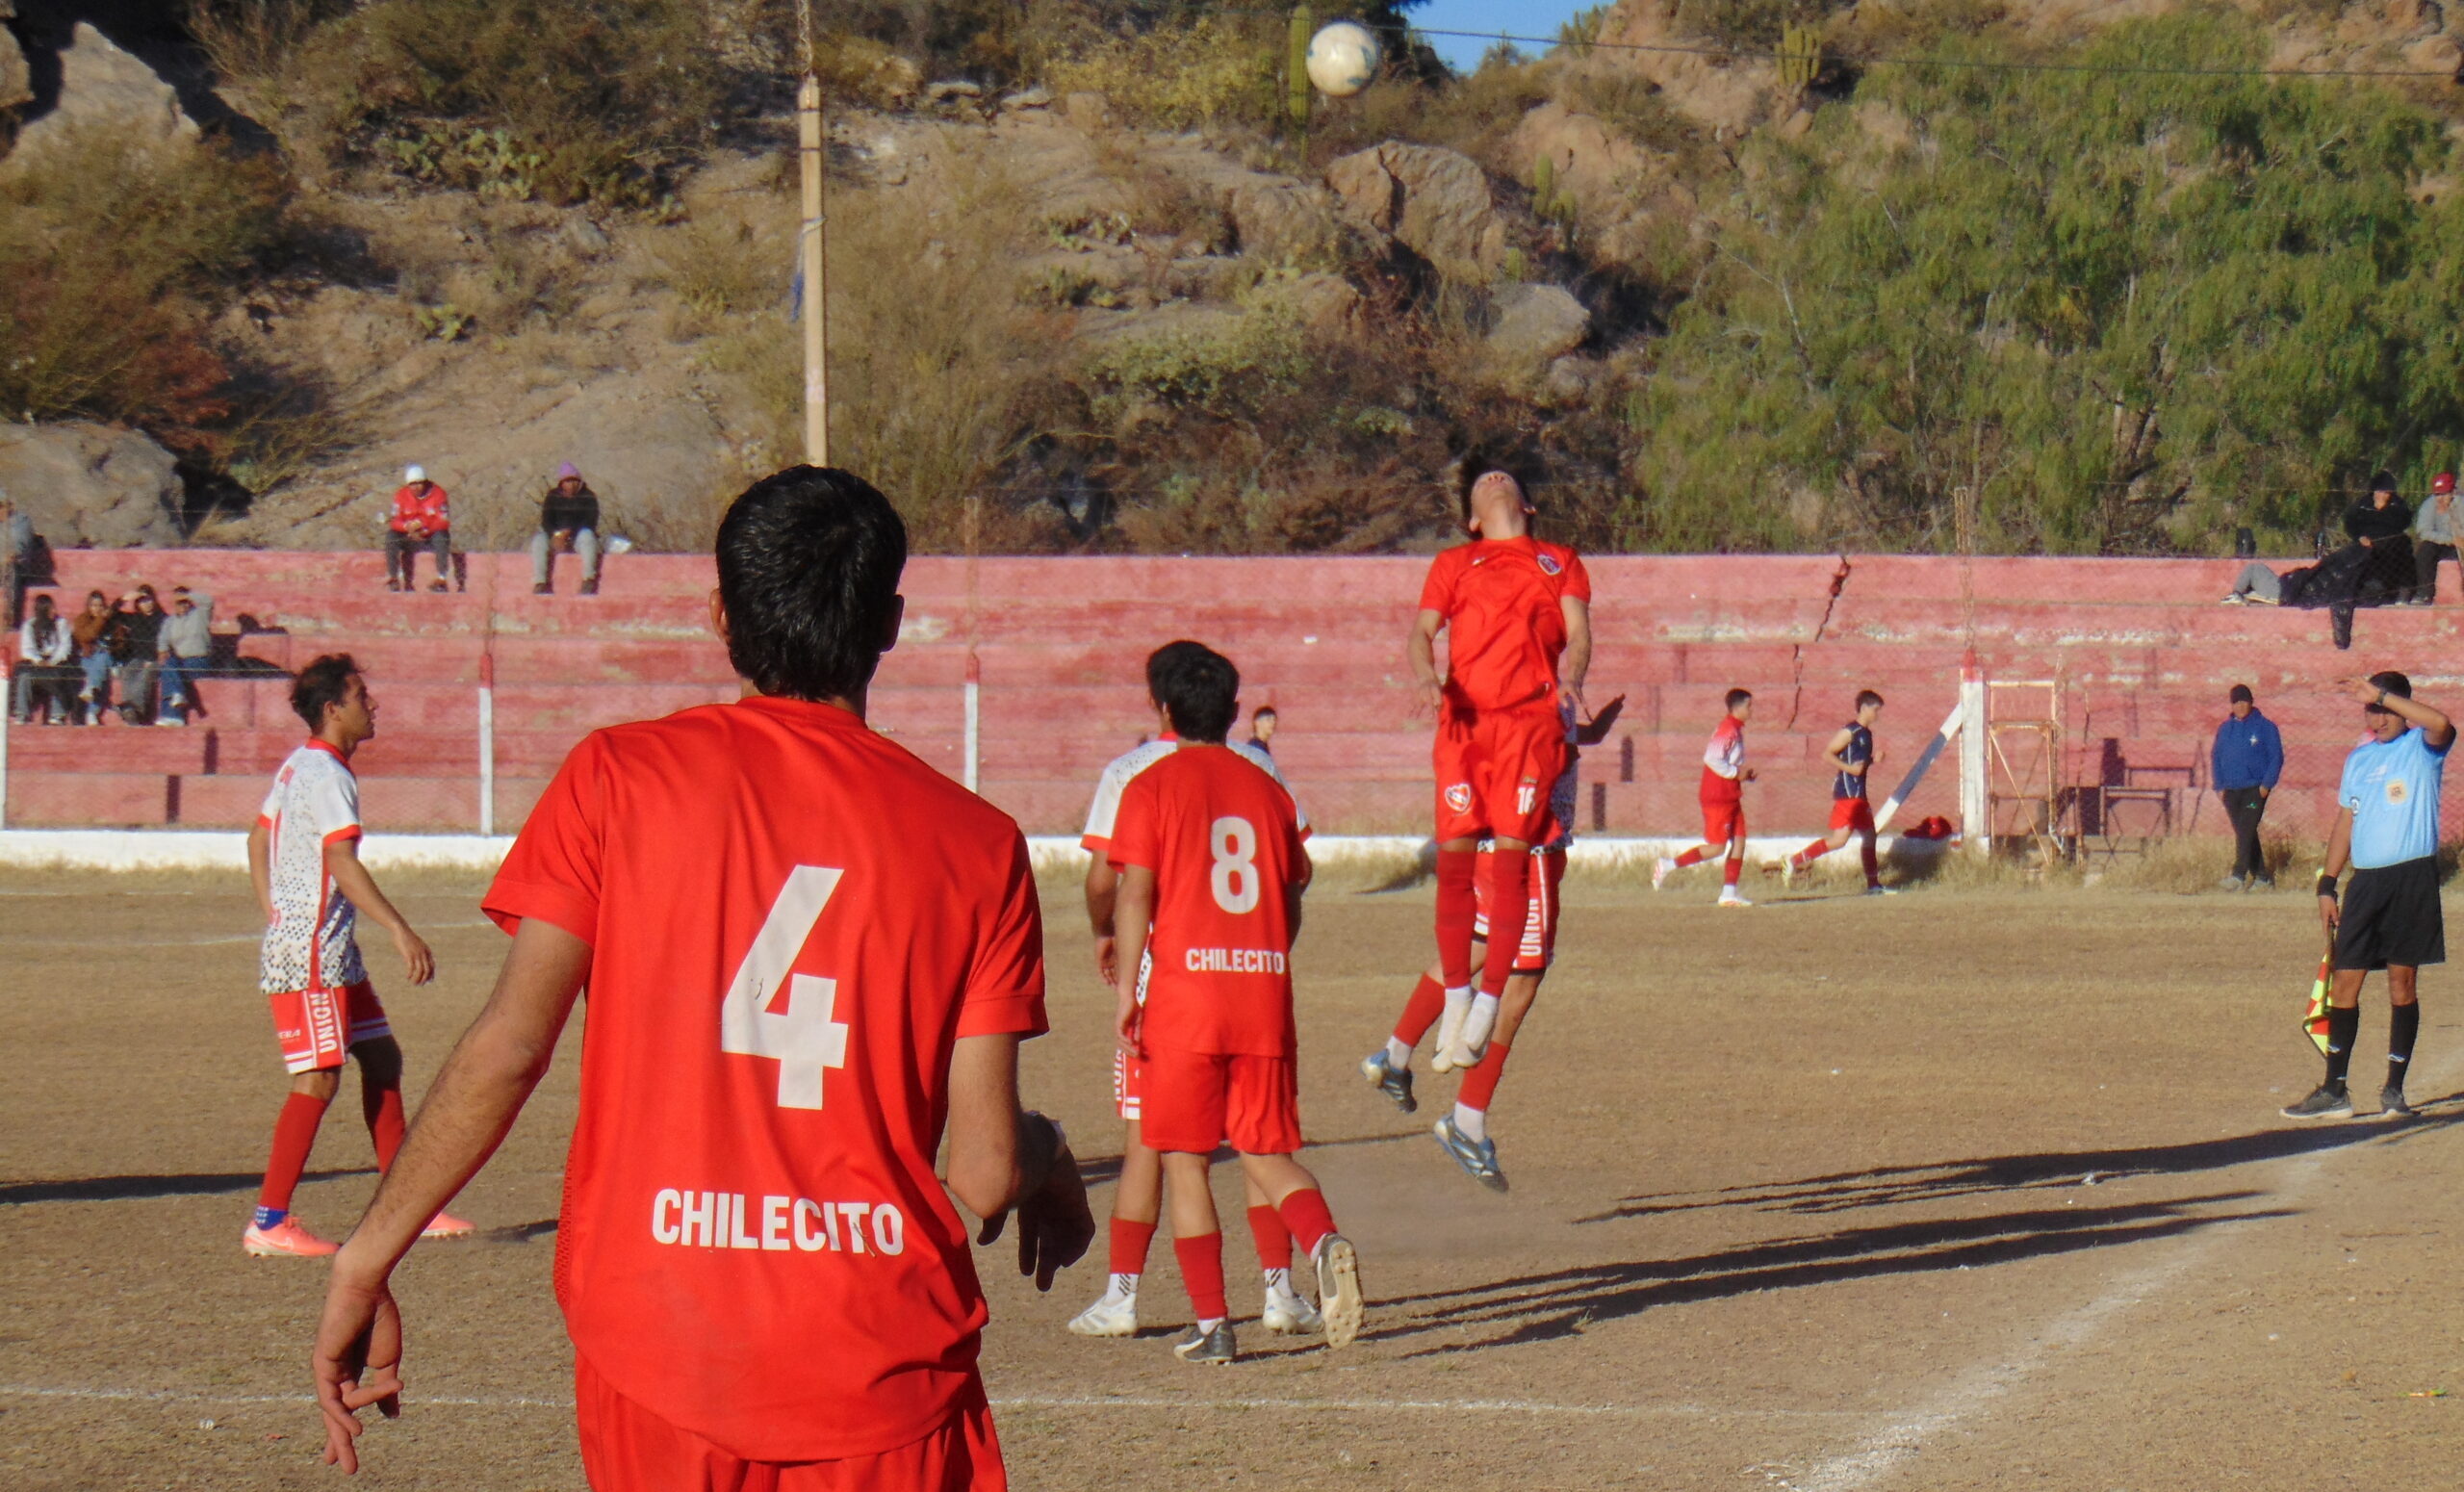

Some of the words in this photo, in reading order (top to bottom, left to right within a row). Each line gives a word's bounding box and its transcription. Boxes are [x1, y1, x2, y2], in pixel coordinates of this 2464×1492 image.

[1211, 816, 1260, 914] 8
[722, 864, 848, 1110] 4
[1186, 947, 1286, 975] CHILECITO
[309, 993, 337, 1054] UNION
[652, 1188, 904, 1256] CHILECITO
